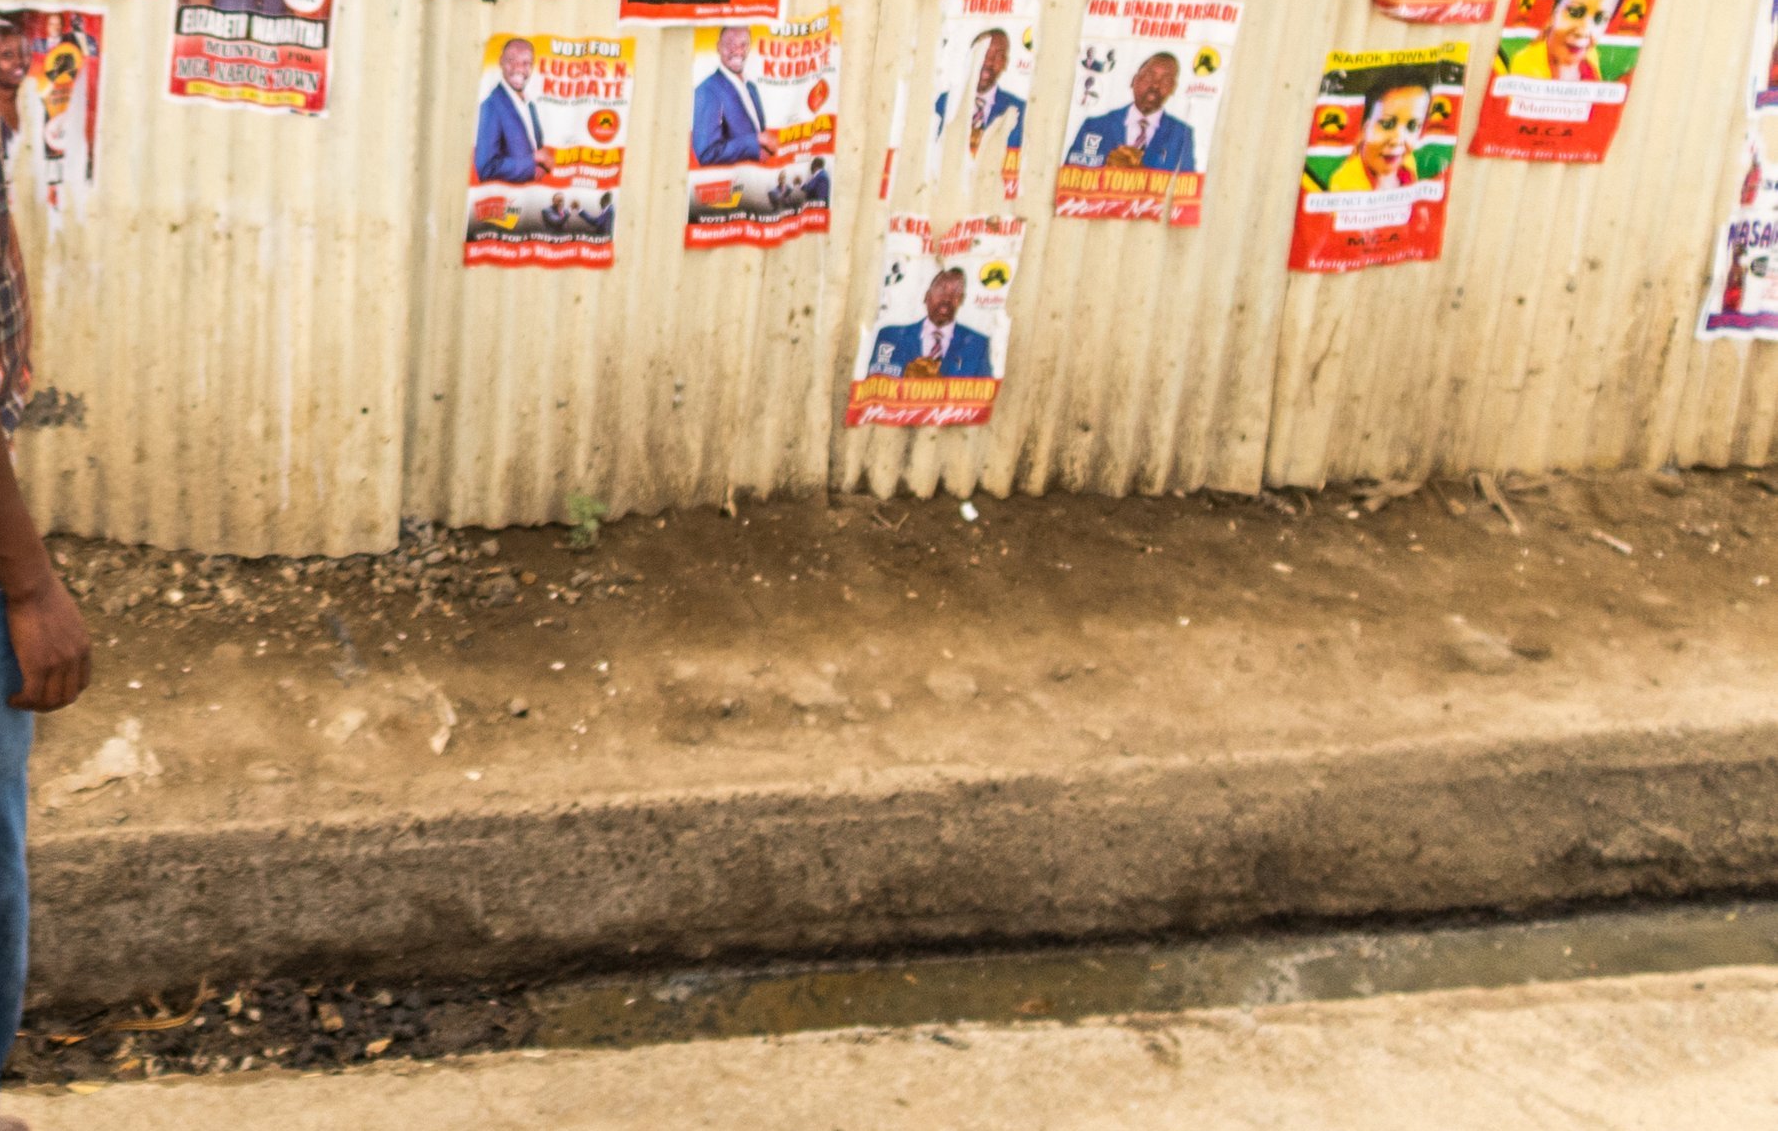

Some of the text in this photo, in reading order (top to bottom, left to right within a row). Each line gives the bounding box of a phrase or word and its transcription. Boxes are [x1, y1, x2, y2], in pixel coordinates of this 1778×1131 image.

[1131, 19, 1189, 39] TOROME
[758, 36, 824, 58] LUCAS
[554, 146, 622, 167] MCA
